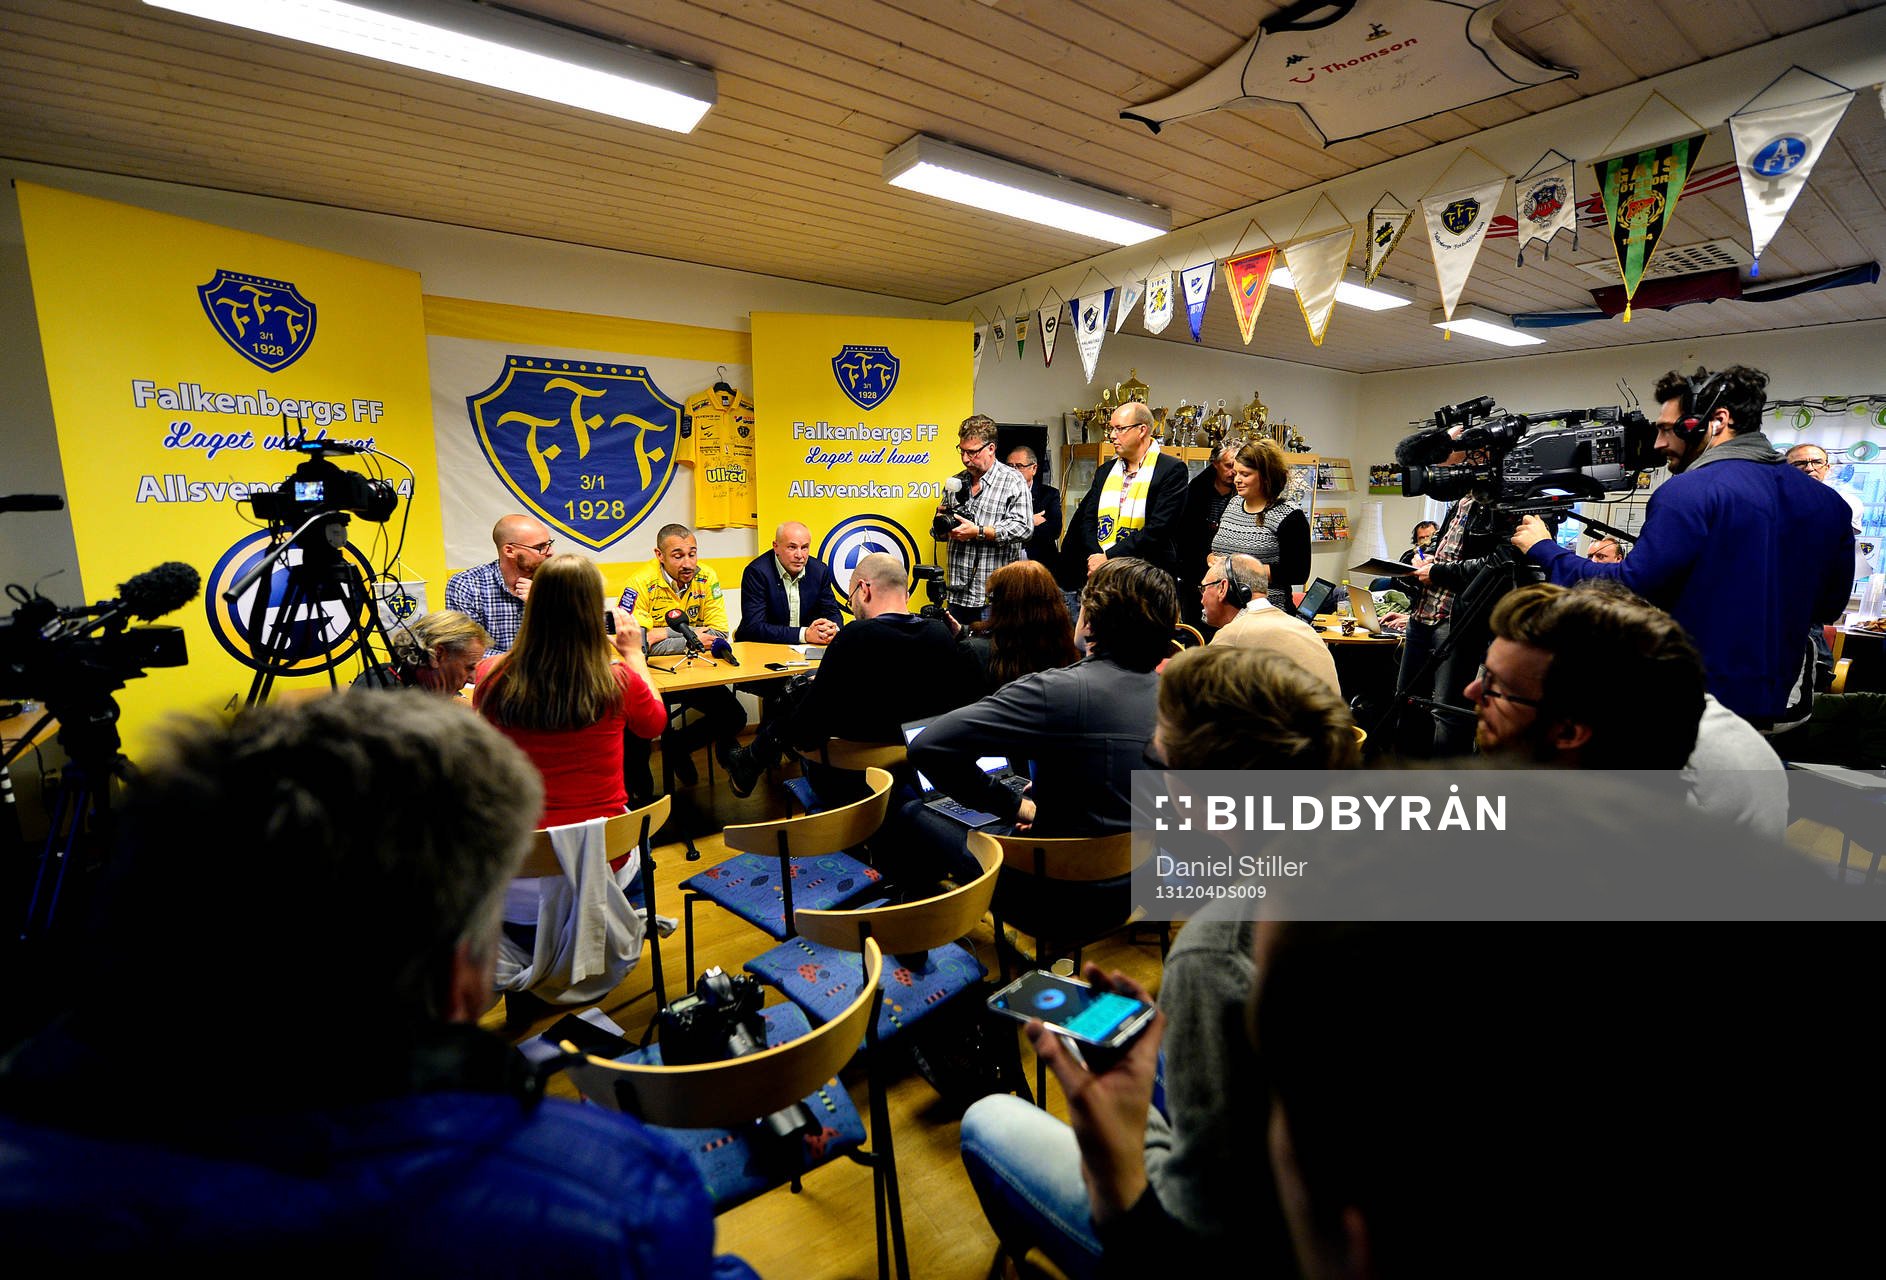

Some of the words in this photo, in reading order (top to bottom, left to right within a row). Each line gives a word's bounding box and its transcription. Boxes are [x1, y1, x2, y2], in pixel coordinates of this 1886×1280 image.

[1321, 38, 1418, 73] Thomson
[1613, 155, 1679, 185] GAIS
[259, 331, 274, 341] 3/1
[252, 342, 285, 357] 1928
[131, 379, 346, 426] Falkenbergs
[352, 398, 384, 423] FF
[858, 391, 878, 399] 1928
[163, 421, 255, 459] Laget
[792, 421, 913, 446] Falkenbergs
[915, 423, 939, 441] FF
[805, 446, 853, 470] Laget
[857, 447, 886, 464] vid
[886, 447, 930, 464] havet
[579, 474, 606, 491] 3/1
[788, 480, 904, 499] Allsvenskan
[906, 481, 942, 499] 201
[564, 499, 626, 521] 1928
